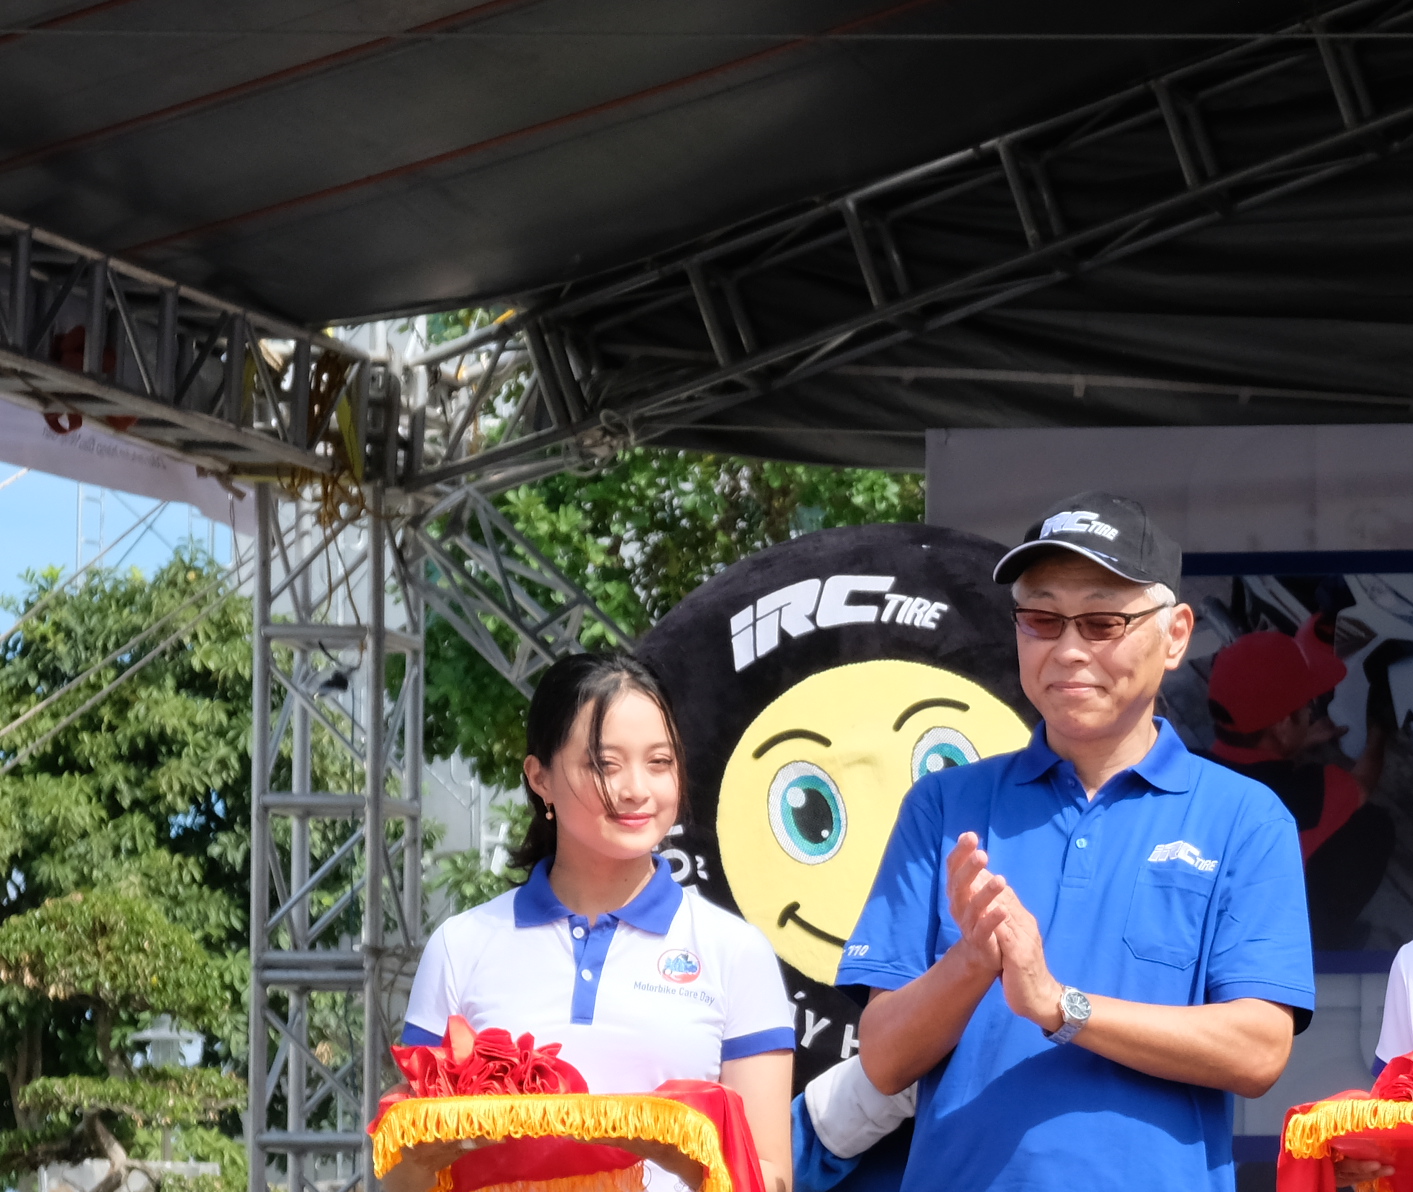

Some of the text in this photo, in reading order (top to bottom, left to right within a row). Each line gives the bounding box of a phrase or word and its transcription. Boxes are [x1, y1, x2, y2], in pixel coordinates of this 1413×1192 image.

[730, 575, 948, 673] IRC TIRE
[1193, 857, 1219, 872] TIRE
[633, 981, 715, 1007] Motorbike Care Day
